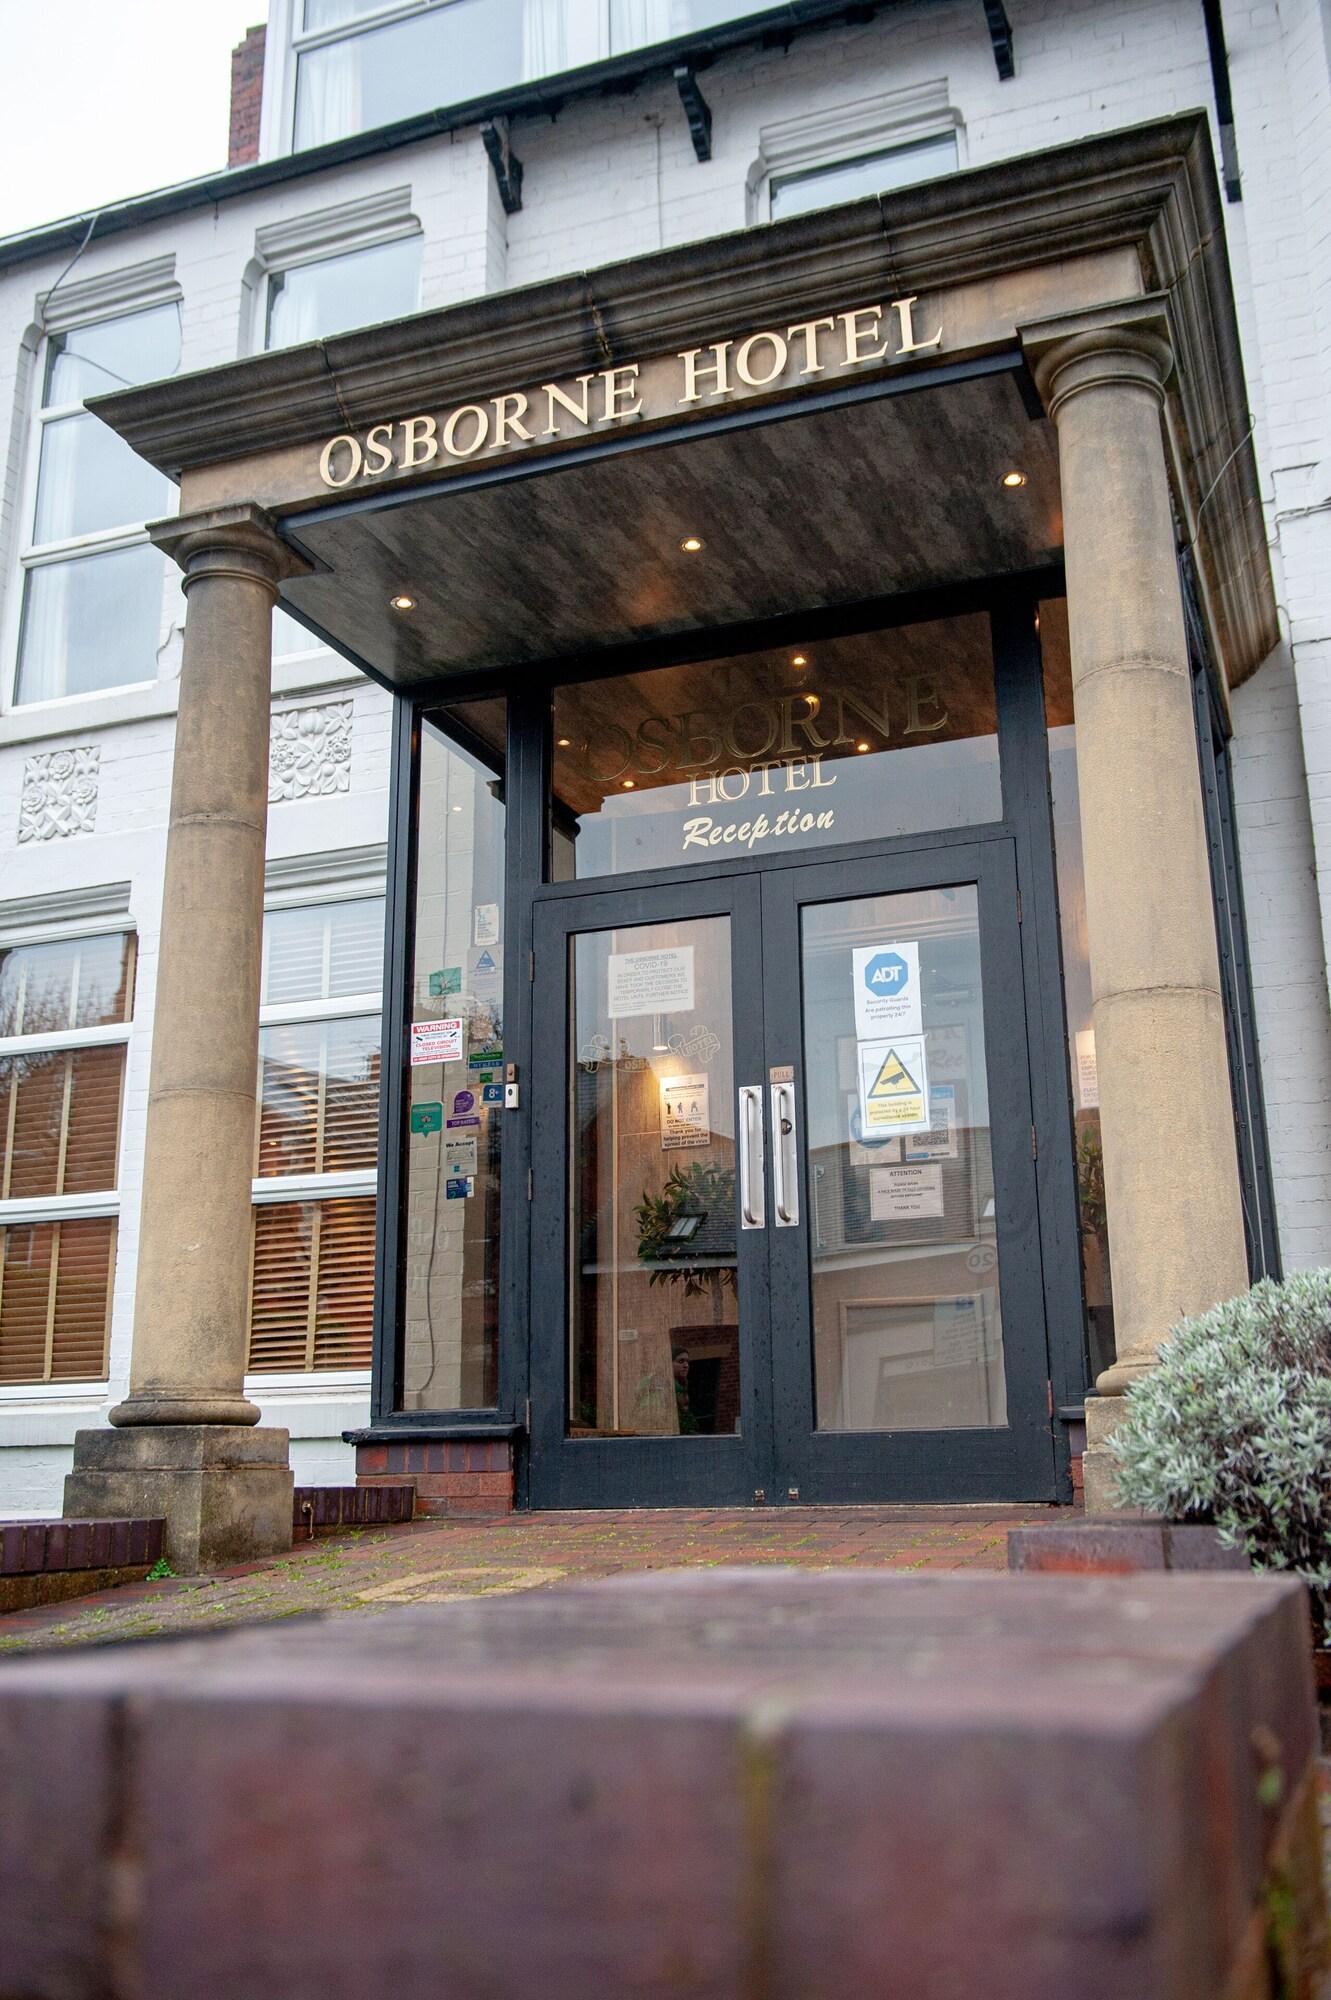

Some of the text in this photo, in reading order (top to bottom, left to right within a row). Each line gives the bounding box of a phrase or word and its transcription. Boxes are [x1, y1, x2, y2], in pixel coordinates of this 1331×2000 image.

[319, 296, 944, 488] OSBORNE HOTEL
[582, 671, 948, 782] OSBORNE
[687, 753, 837, 806] HOTEL
[682, 808, 836, 849] Reception
[871, 965, 903, 984] ADT
[416, 1022, 457, 1033] WARNING
[890, 1169, 922, 1177] ATTENTION
